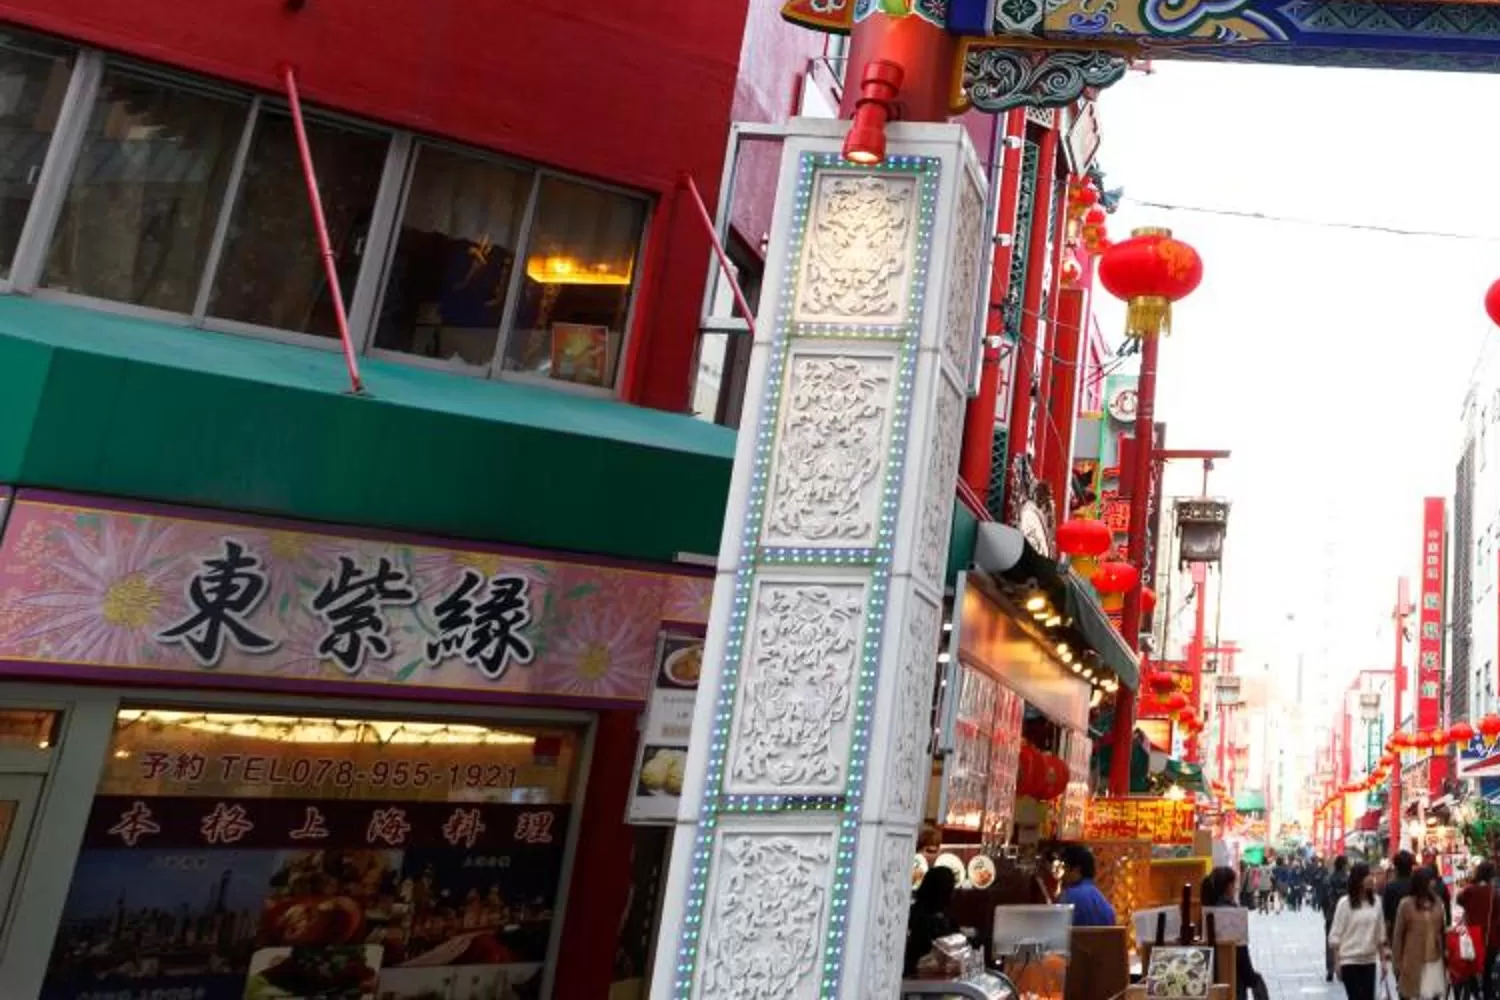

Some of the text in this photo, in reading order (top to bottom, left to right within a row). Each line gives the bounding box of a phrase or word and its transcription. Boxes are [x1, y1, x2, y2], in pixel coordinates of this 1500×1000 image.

[141, 752, 203, 781] 予約
[107, 802, 553, 847] 本格上海料理
